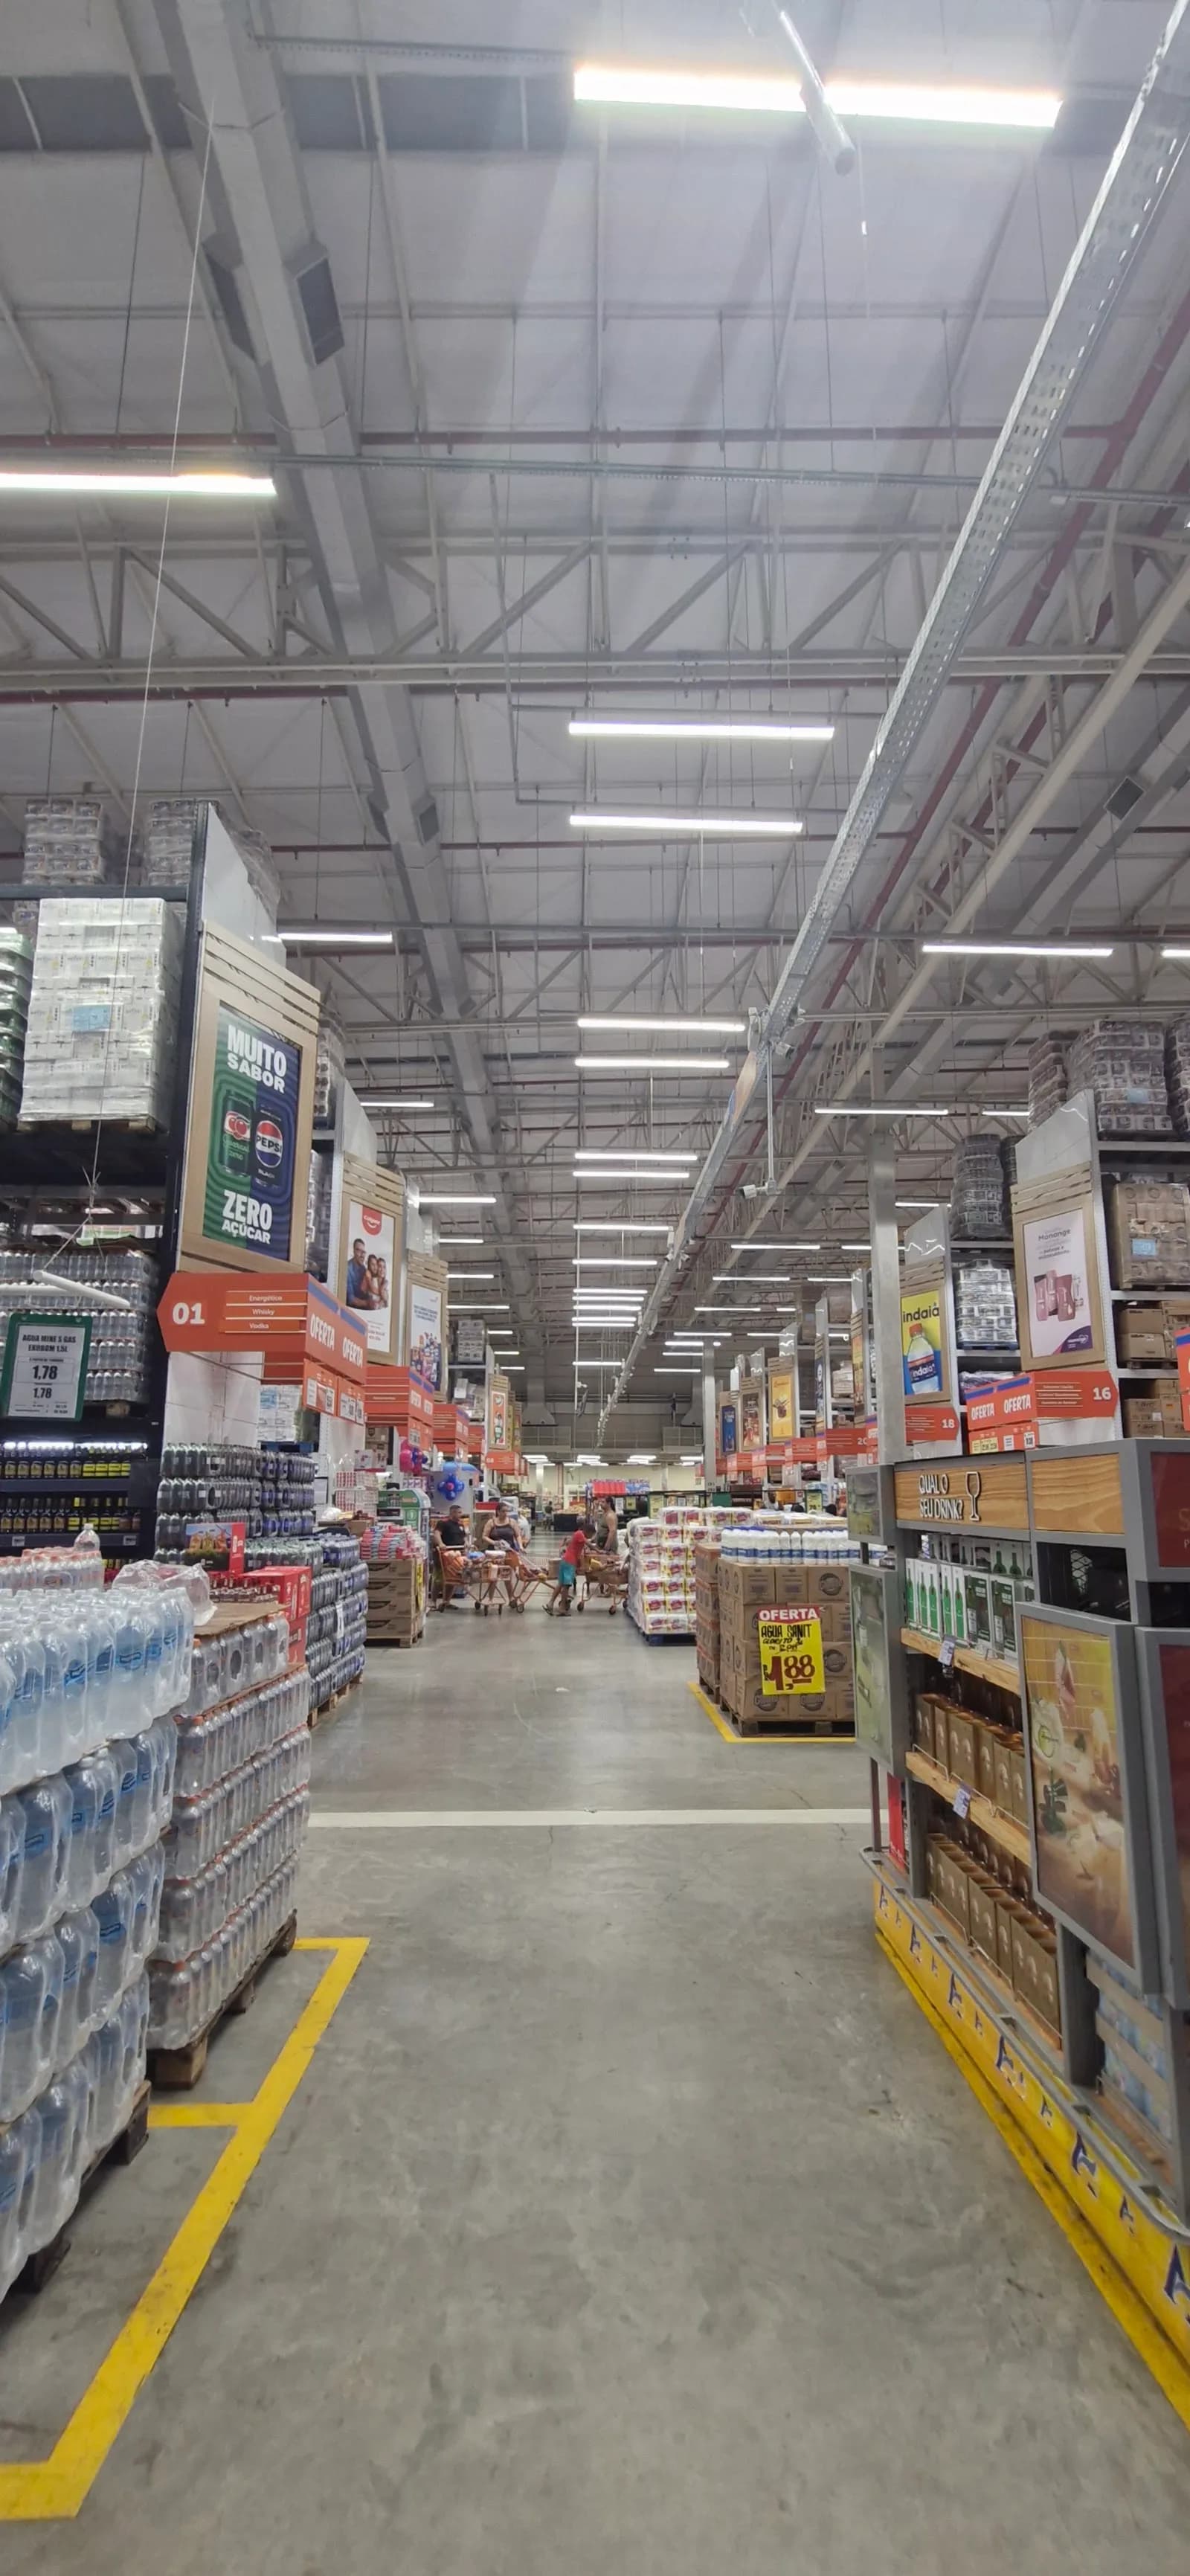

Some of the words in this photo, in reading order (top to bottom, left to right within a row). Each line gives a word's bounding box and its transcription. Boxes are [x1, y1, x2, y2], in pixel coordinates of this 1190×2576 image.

[227, 1024, 286, 1077] MUITO
[227, 1053, 286, 1093] SABOR
[222, 1189, 273, 1231] ZERO
[222, 1218, 271, 1244] AÇÚCAR
[172, 1303, 205, 1325] 01
[252, 1308, 275, 1316] Whisky
[310, 1314, 335, 1350] OFERTA
[342, 1337, 363, 1369] OFERTA
[32, 1365, 58, 1380] 1,78
[1093, 1387, 1112, 1400] 16
[971, 1402, 994, 1420] OFERTA
[1004, 1394, 1031, 1413] OFERTA
[942, 1419, 955, 1429] 18
[919, 1474, 940, 1494] QUAL
[941, 1474, 949, 1494] O
[920, 1498, 933, 1517] SEU
[934, 1499, 963, 1520] DRINK?
[759, 1608, 818, 1620] OFERTA
